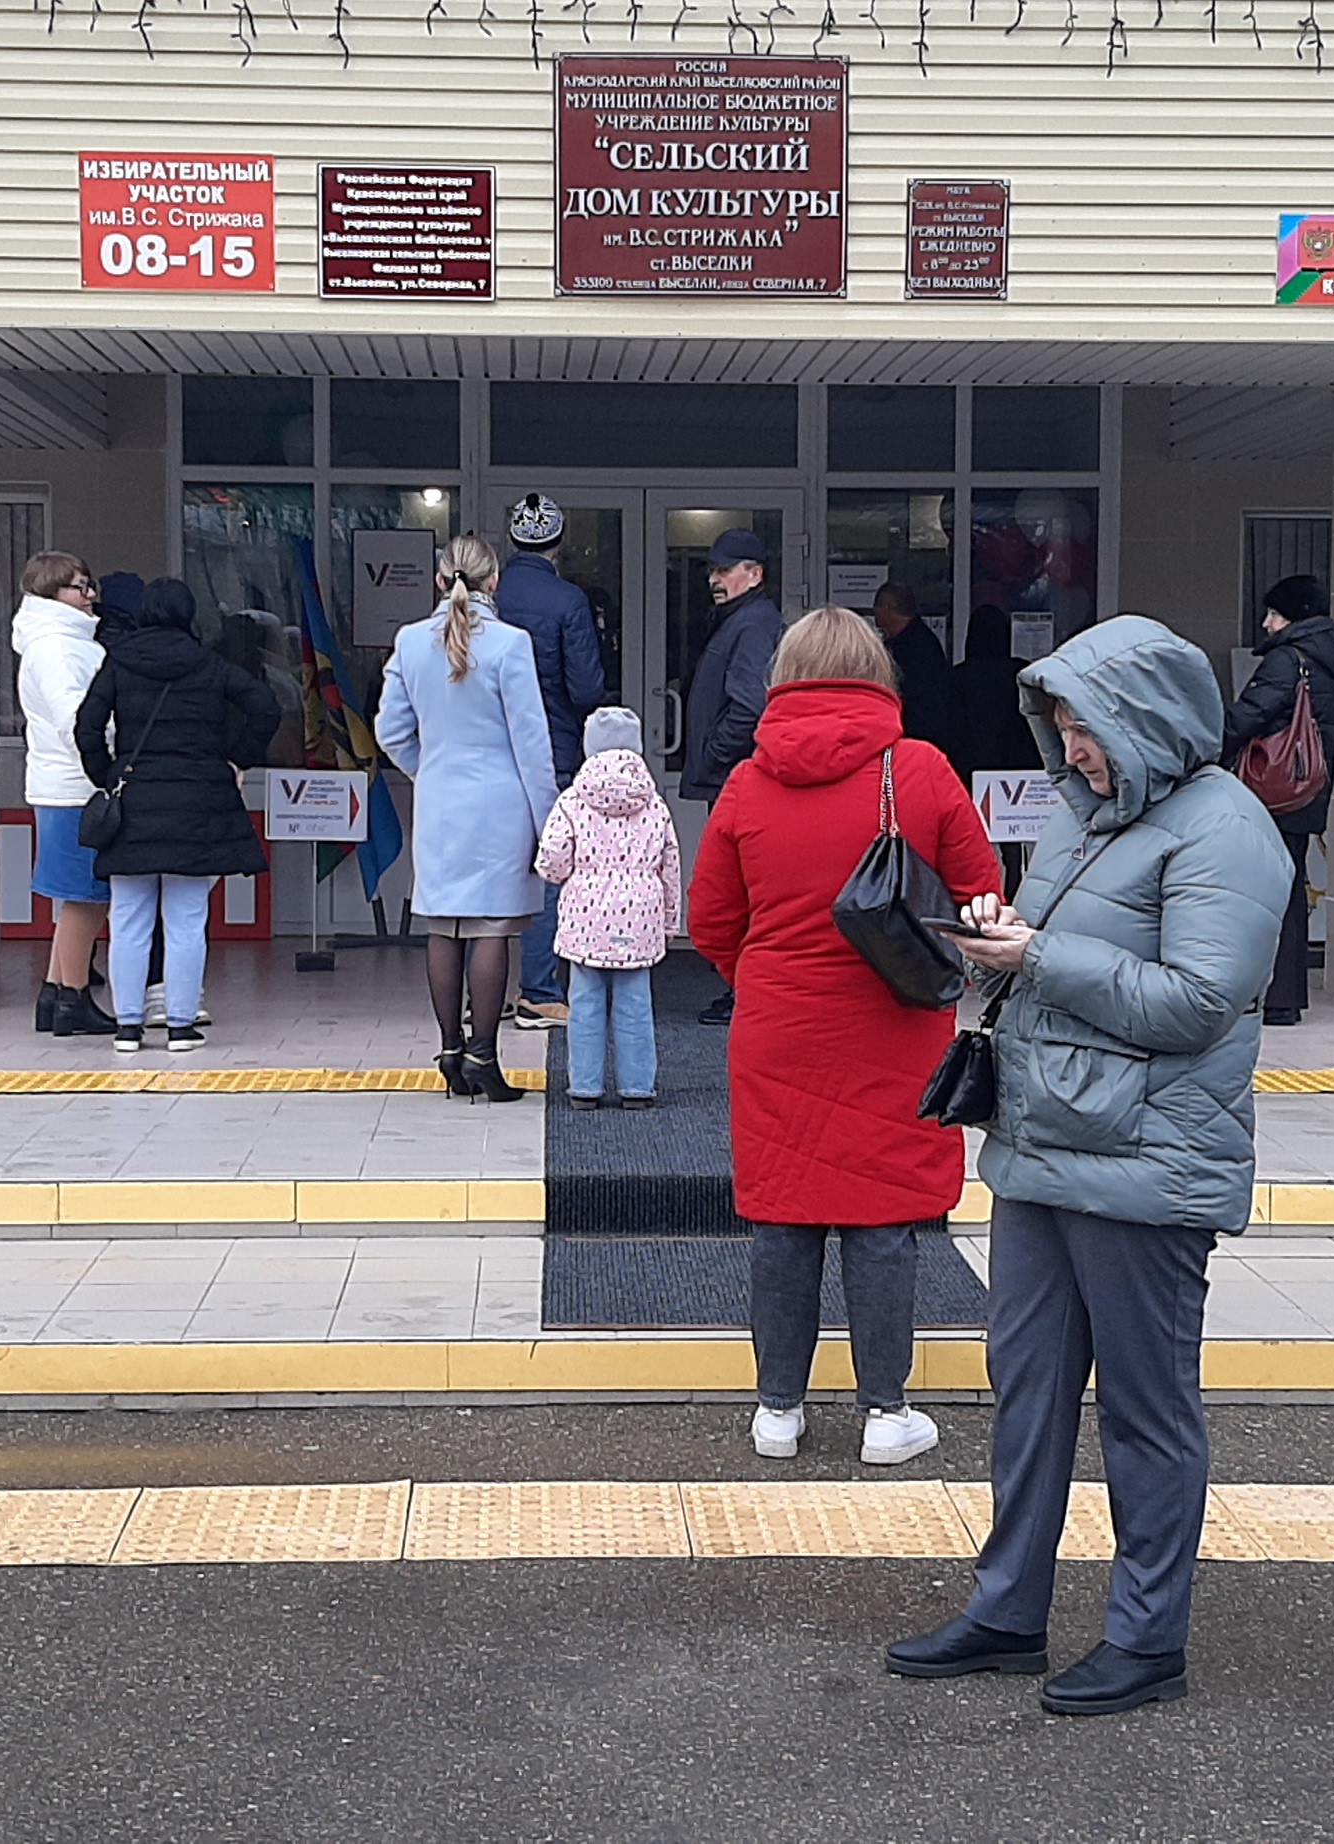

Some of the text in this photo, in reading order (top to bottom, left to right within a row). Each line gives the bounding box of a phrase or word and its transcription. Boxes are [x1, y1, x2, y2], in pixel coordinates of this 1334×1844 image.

[675, 60, 727, 73] РОССИЯ
[563, 74, 841, 90] КРАСНОДАРСКИЙ КРАЙ ВЫСЕЛКОВСКИЙ РАЙОН
[565, 92, 838, 112] МУНИЦИПАЛЬНОЕ БЮДЖЕТНОЕ
[595, 114, 810, 133] УЧРЕЖДЕНИЕ КУЛЬТУРЫ
[83, 160, 268, 182] ИЗБИРАТЕЛЬНЫЙ
[337, 173, 473, 187] Российская Федерация
[128, 184, 225, 204] УЧАСТОК
[346, 188, 436, 200] Краснодарский
[563, 188, 840, 219] ДОМ КУЛЬТУРЫ
[167, 208, 264, 231] Стрижака
[956, 226, 1004, 238] РАБОТЫ
[919, 240, 996, 252] ЕЖЕДНЕВНО
[99, 234, 255, 278] 08-15
[933, 277, 1001, 289] ВЫХОДНЫХ
